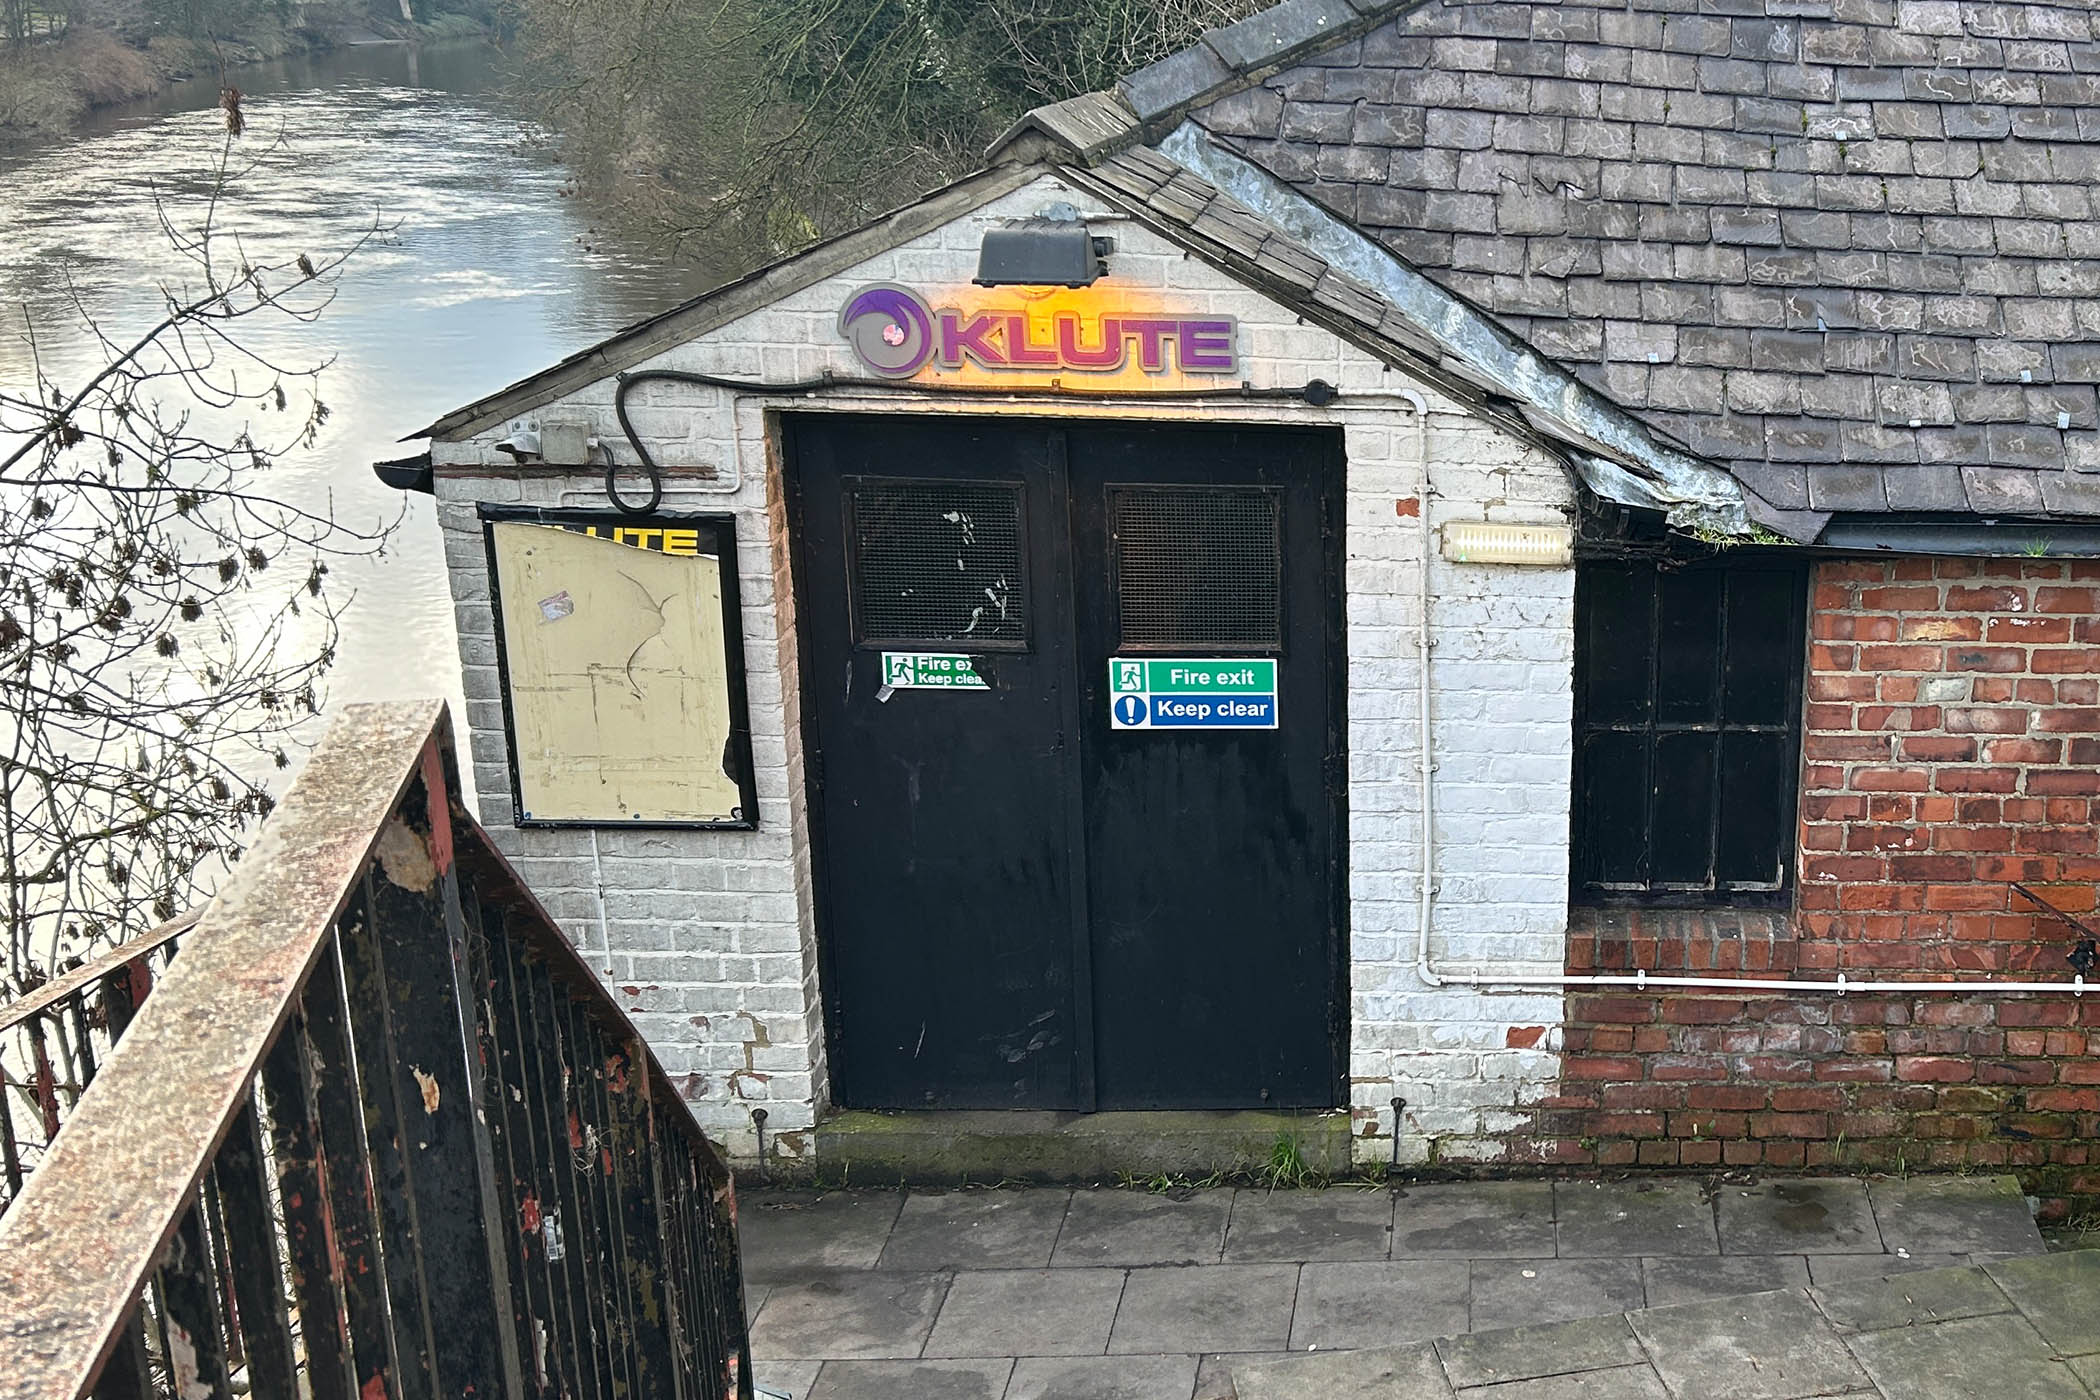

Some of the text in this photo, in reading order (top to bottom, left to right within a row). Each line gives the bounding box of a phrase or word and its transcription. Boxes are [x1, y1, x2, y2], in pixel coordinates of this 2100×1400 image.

[941, 314, 1233, 367] KLUTE
[917, 656, 951, 671] Fire
[918, 672, 952, 686] Keep
[1170, 668, 1255, 685] Fire exit
[1157, 700, 1268, 720] Keep clear
